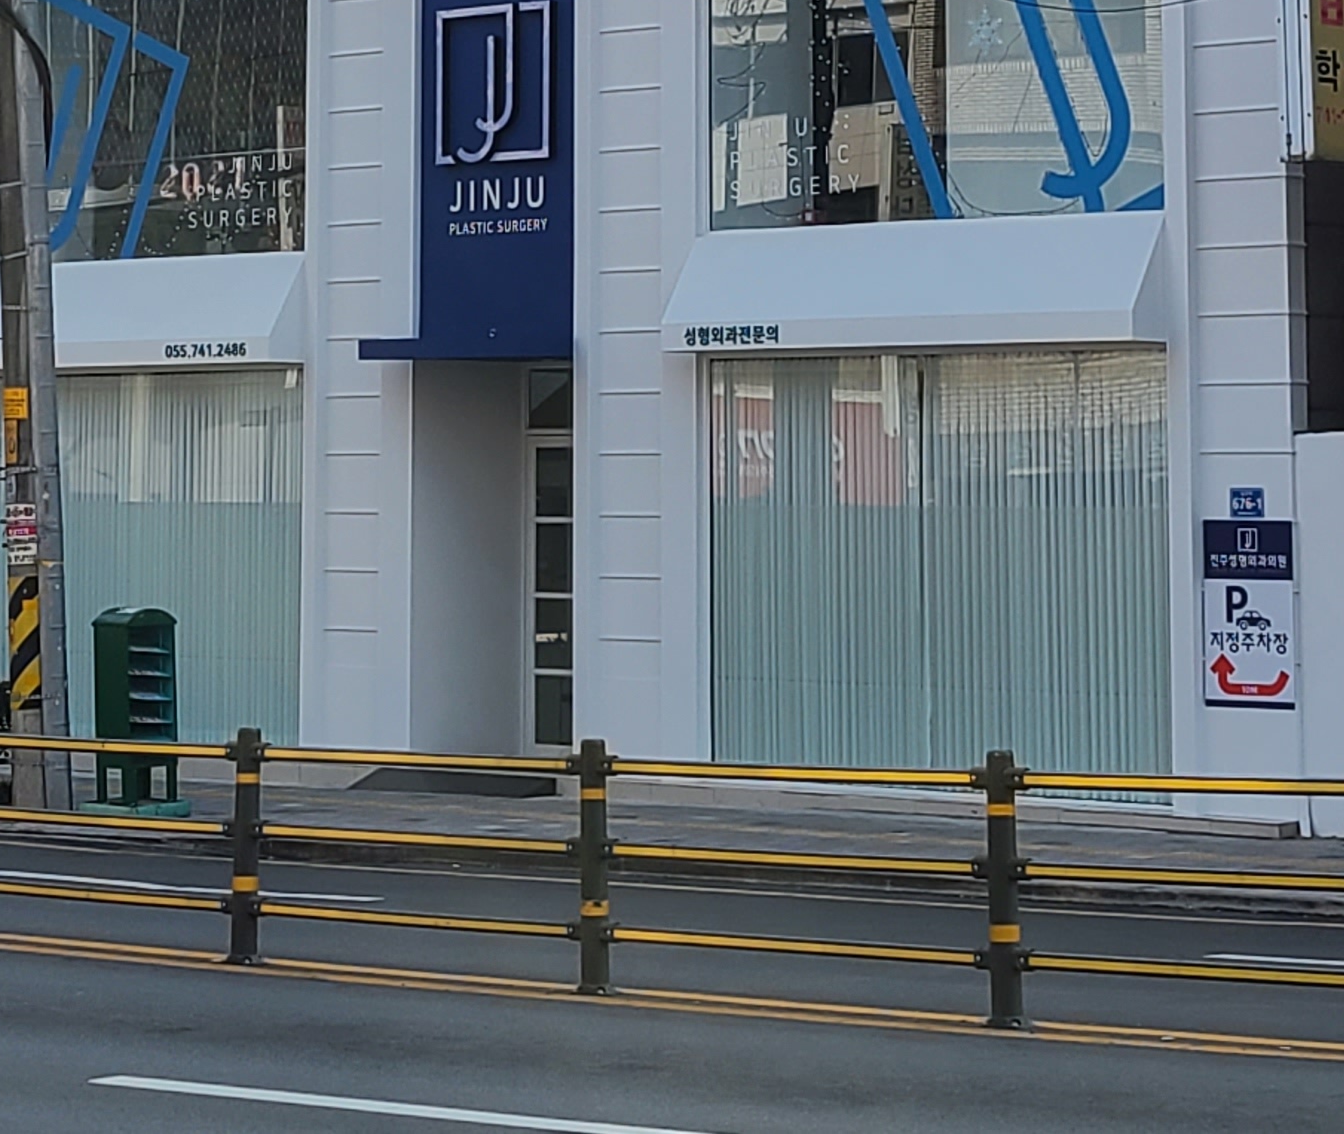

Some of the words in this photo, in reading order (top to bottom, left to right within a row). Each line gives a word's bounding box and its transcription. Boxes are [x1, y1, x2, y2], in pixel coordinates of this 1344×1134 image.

[448, 175, 546, 214] JINJU
[448, 221, 494, 236] PLASTIC
[497, 217, 549, 234] SURGERY
[684, 325, 780, 346] 성형외과전문의
[164, 343, 248, 359] 055.741.2486
[1210, 554, 1287, 568] 진주성형외과의원
[1226, 586, 1248, 624] P
[1210, 631, 1289, 655] 지정주차장
